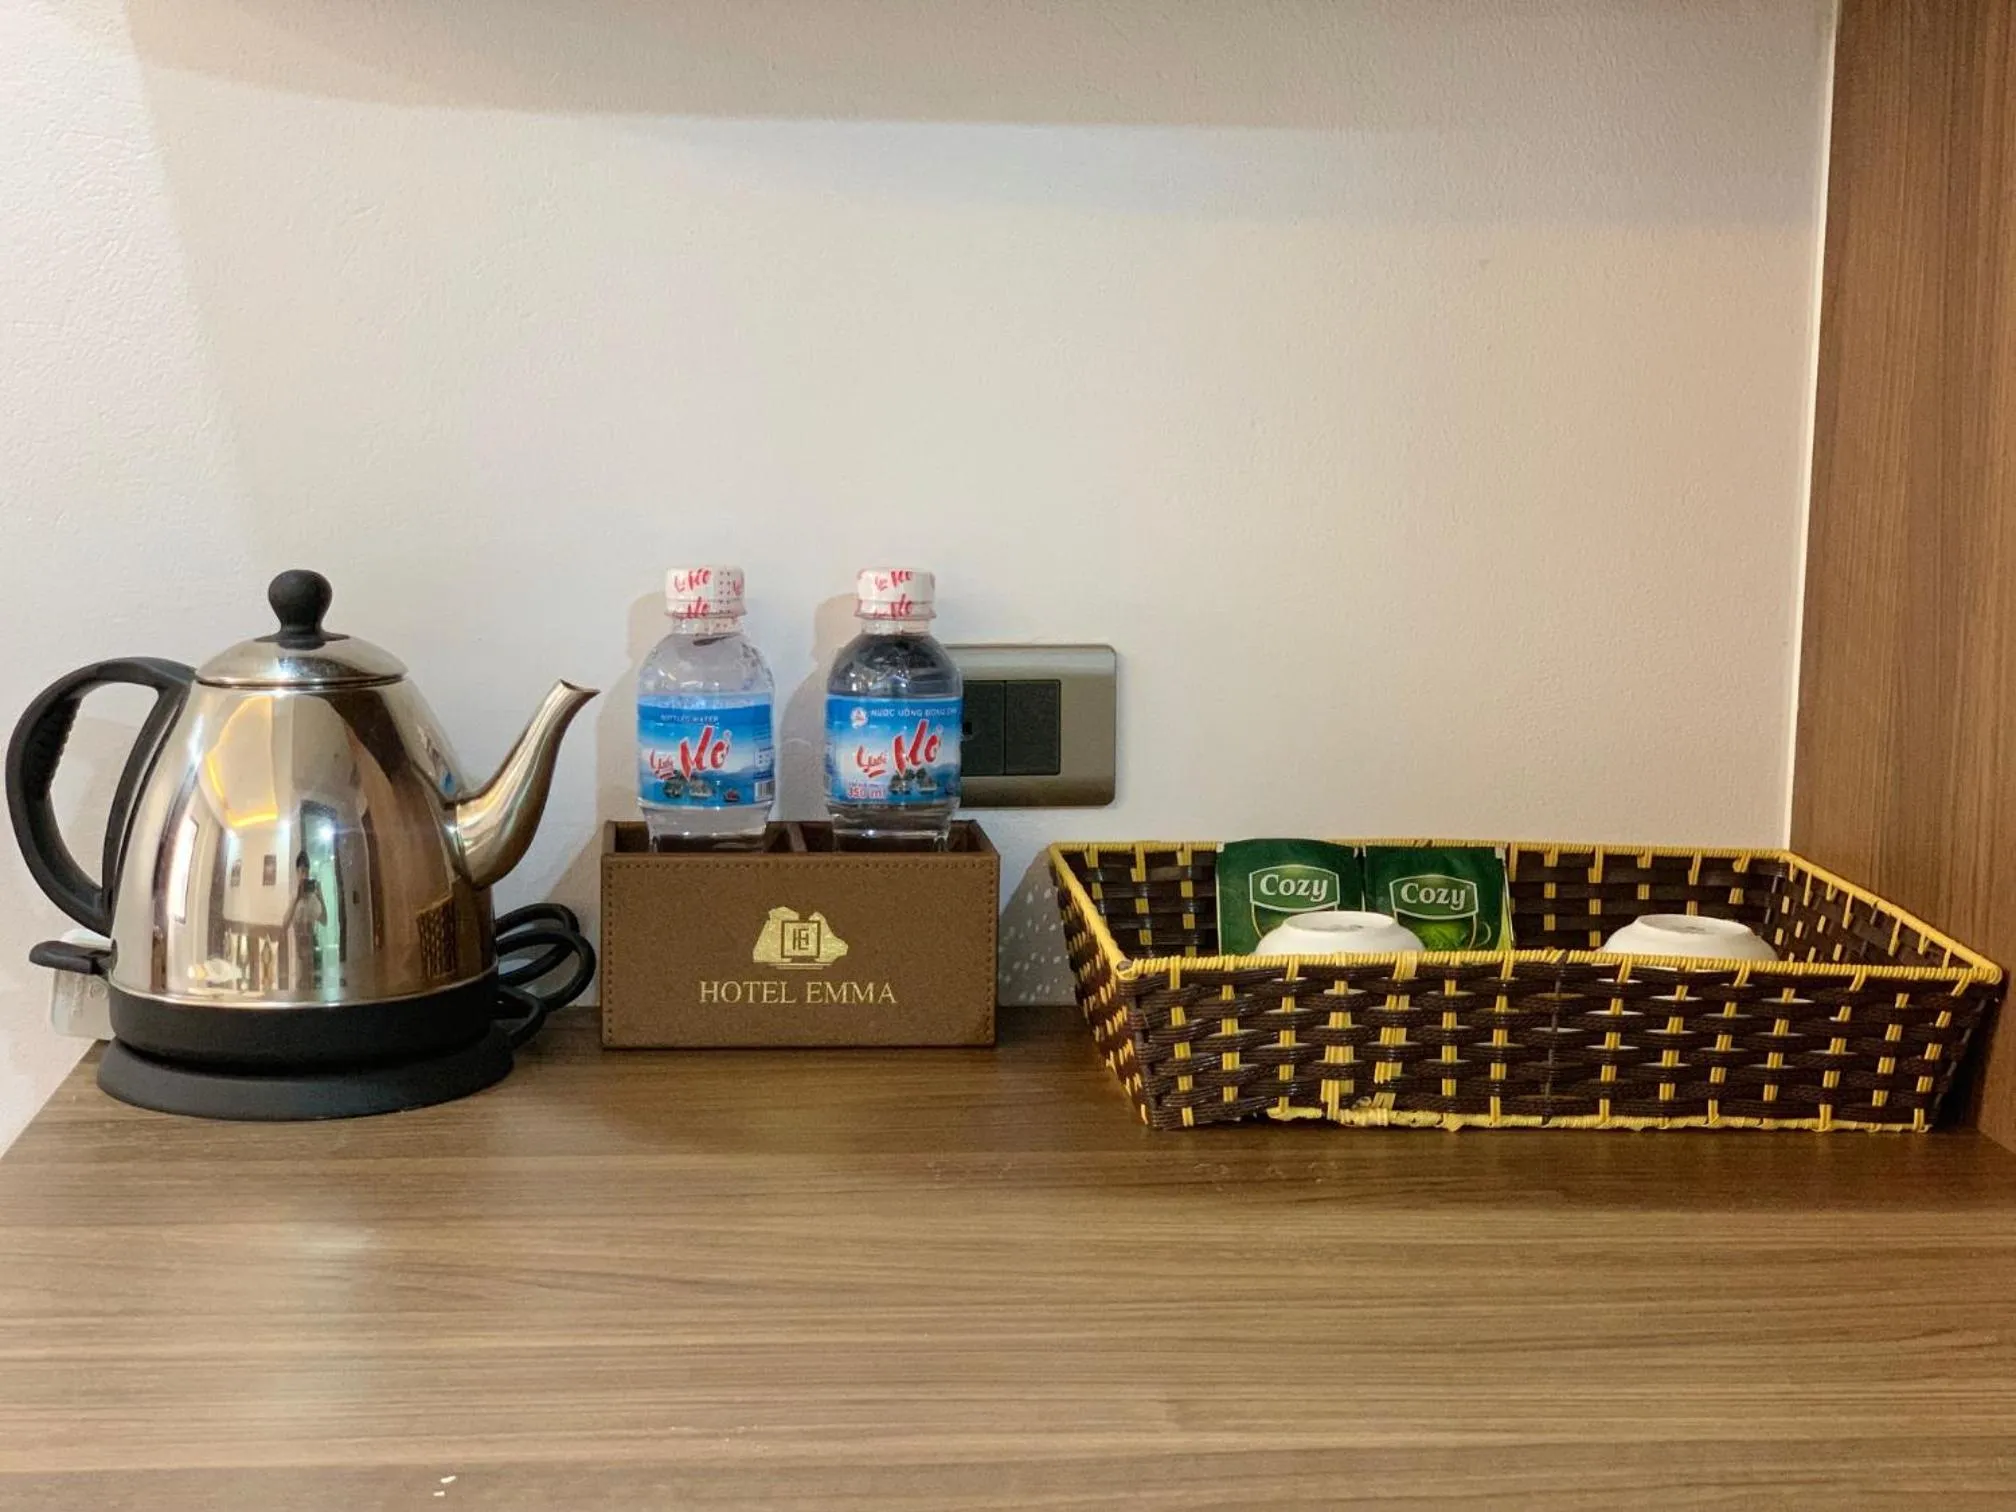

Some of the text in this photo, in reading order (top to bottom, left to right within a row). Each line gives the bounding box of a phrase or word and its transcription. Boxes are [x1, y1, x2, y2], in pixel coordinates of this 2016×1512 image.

[1259, 873, 1330, 902] Cozy
[1400, 882, 1467, 911] Cozy
[699, 980, 898, 1005] HOTEL EMMA
